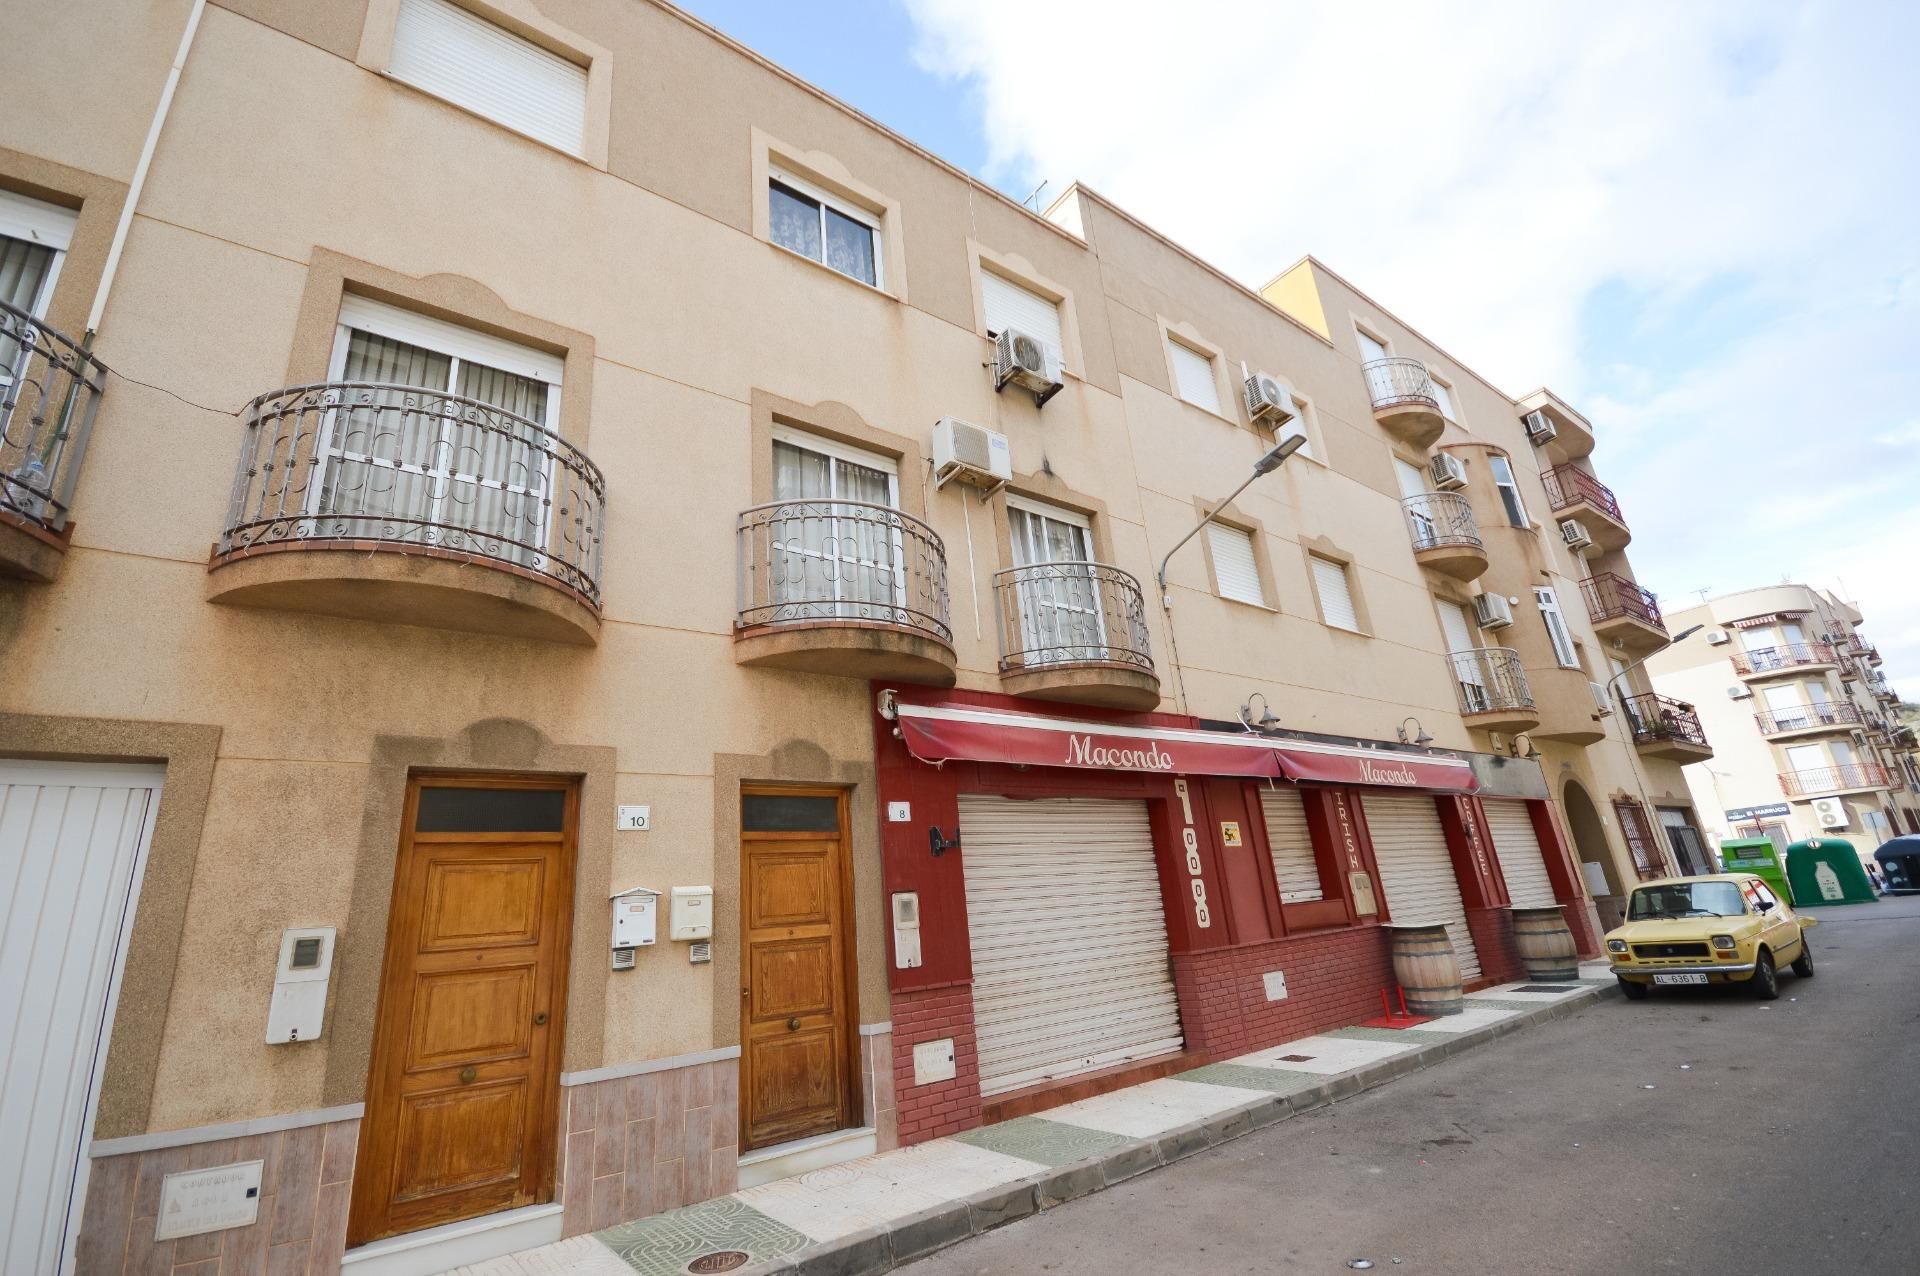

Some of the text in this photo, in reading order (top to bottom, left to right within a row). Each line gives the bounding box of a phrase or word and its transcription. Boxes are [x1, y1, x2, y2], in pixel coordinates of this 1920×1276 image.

[1065, 735, 1175, 769] Macondo
[1359, 759, 1418, 785] Macondo
[630, 816, 645, 827] 10
[899, 809, 906, 819] 8
[1335, 792, 1359, 868] IRISH
[1174, 773, 1211, 929] 988
